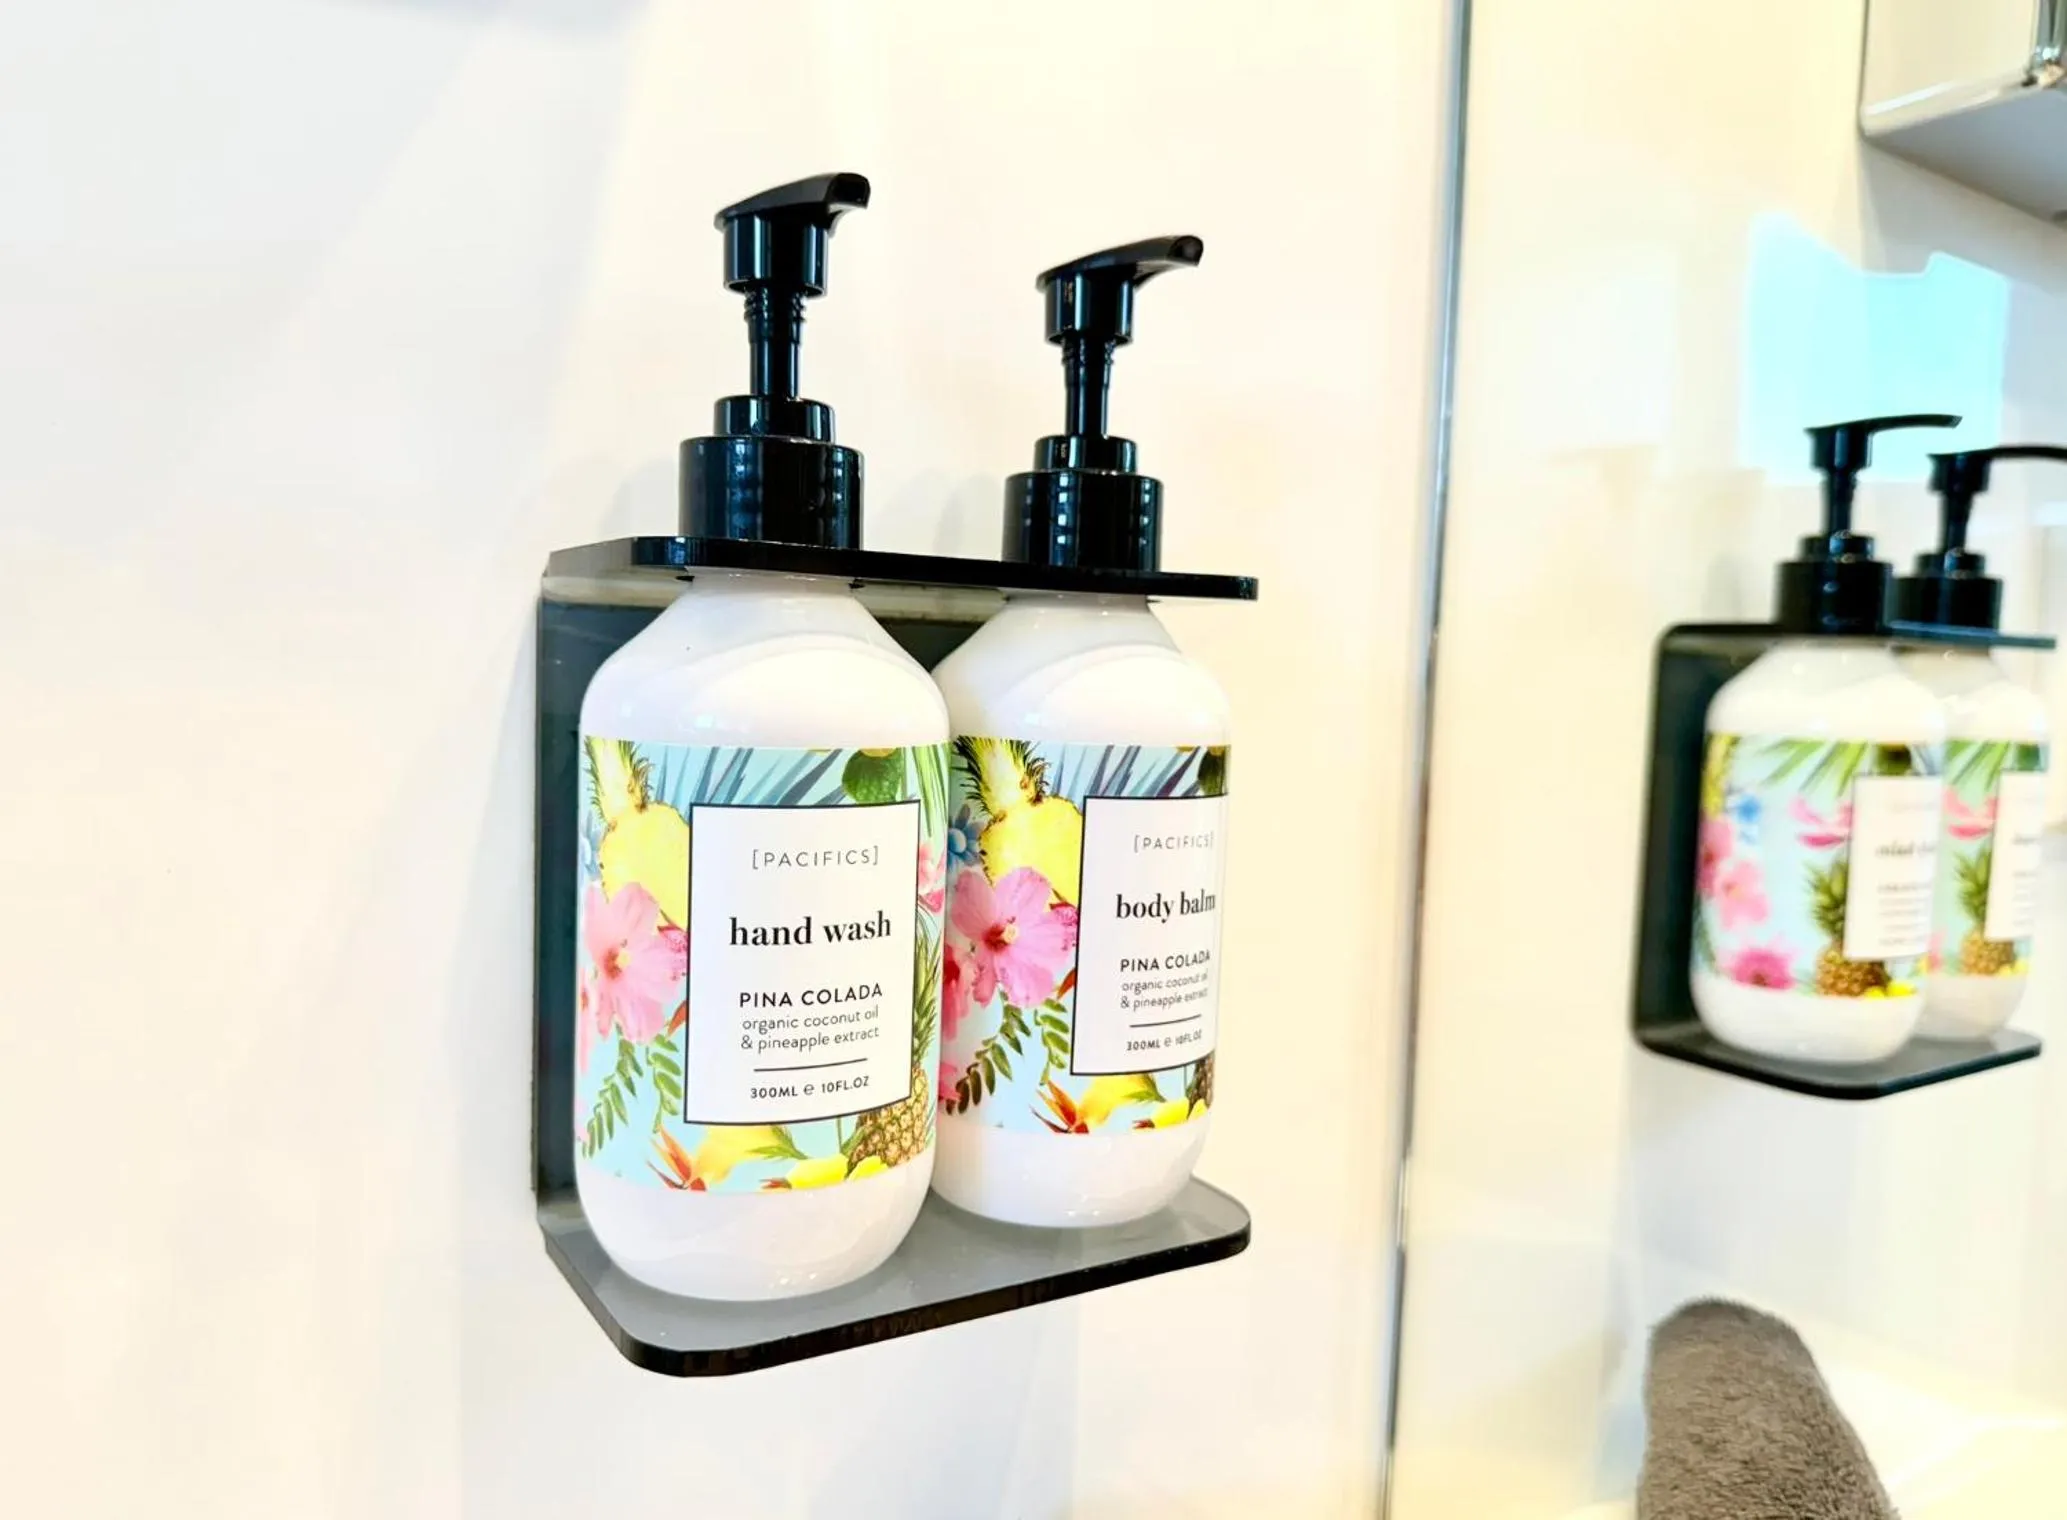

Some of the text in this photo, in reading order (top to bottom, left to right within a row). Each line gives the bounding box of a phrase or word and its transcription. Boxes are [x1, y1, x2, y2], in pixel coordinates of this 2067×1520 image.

[752, 846, 879, 869] [PACIFICS]
[1116, 888, 1215, 923] body balm
[730, 910, 891, 946] hand wash
[1120, 949, 1210, 972] PINA COLADA
[739, 983, 883, 1007] PINA COLADA
[1122, 980, 1162, 995] organic
[1120, 996, 1129, 1008] &
[1133, 992, 1182, 1012] pineapple
[742, 1004, 879, 1035] organic coconut oil
[741, 1027, 879, 1054] & pineapple extract
[750, 1086, 798, 1099] 300ML
[821, 1075, 870, 1094] 10FL.OZ
